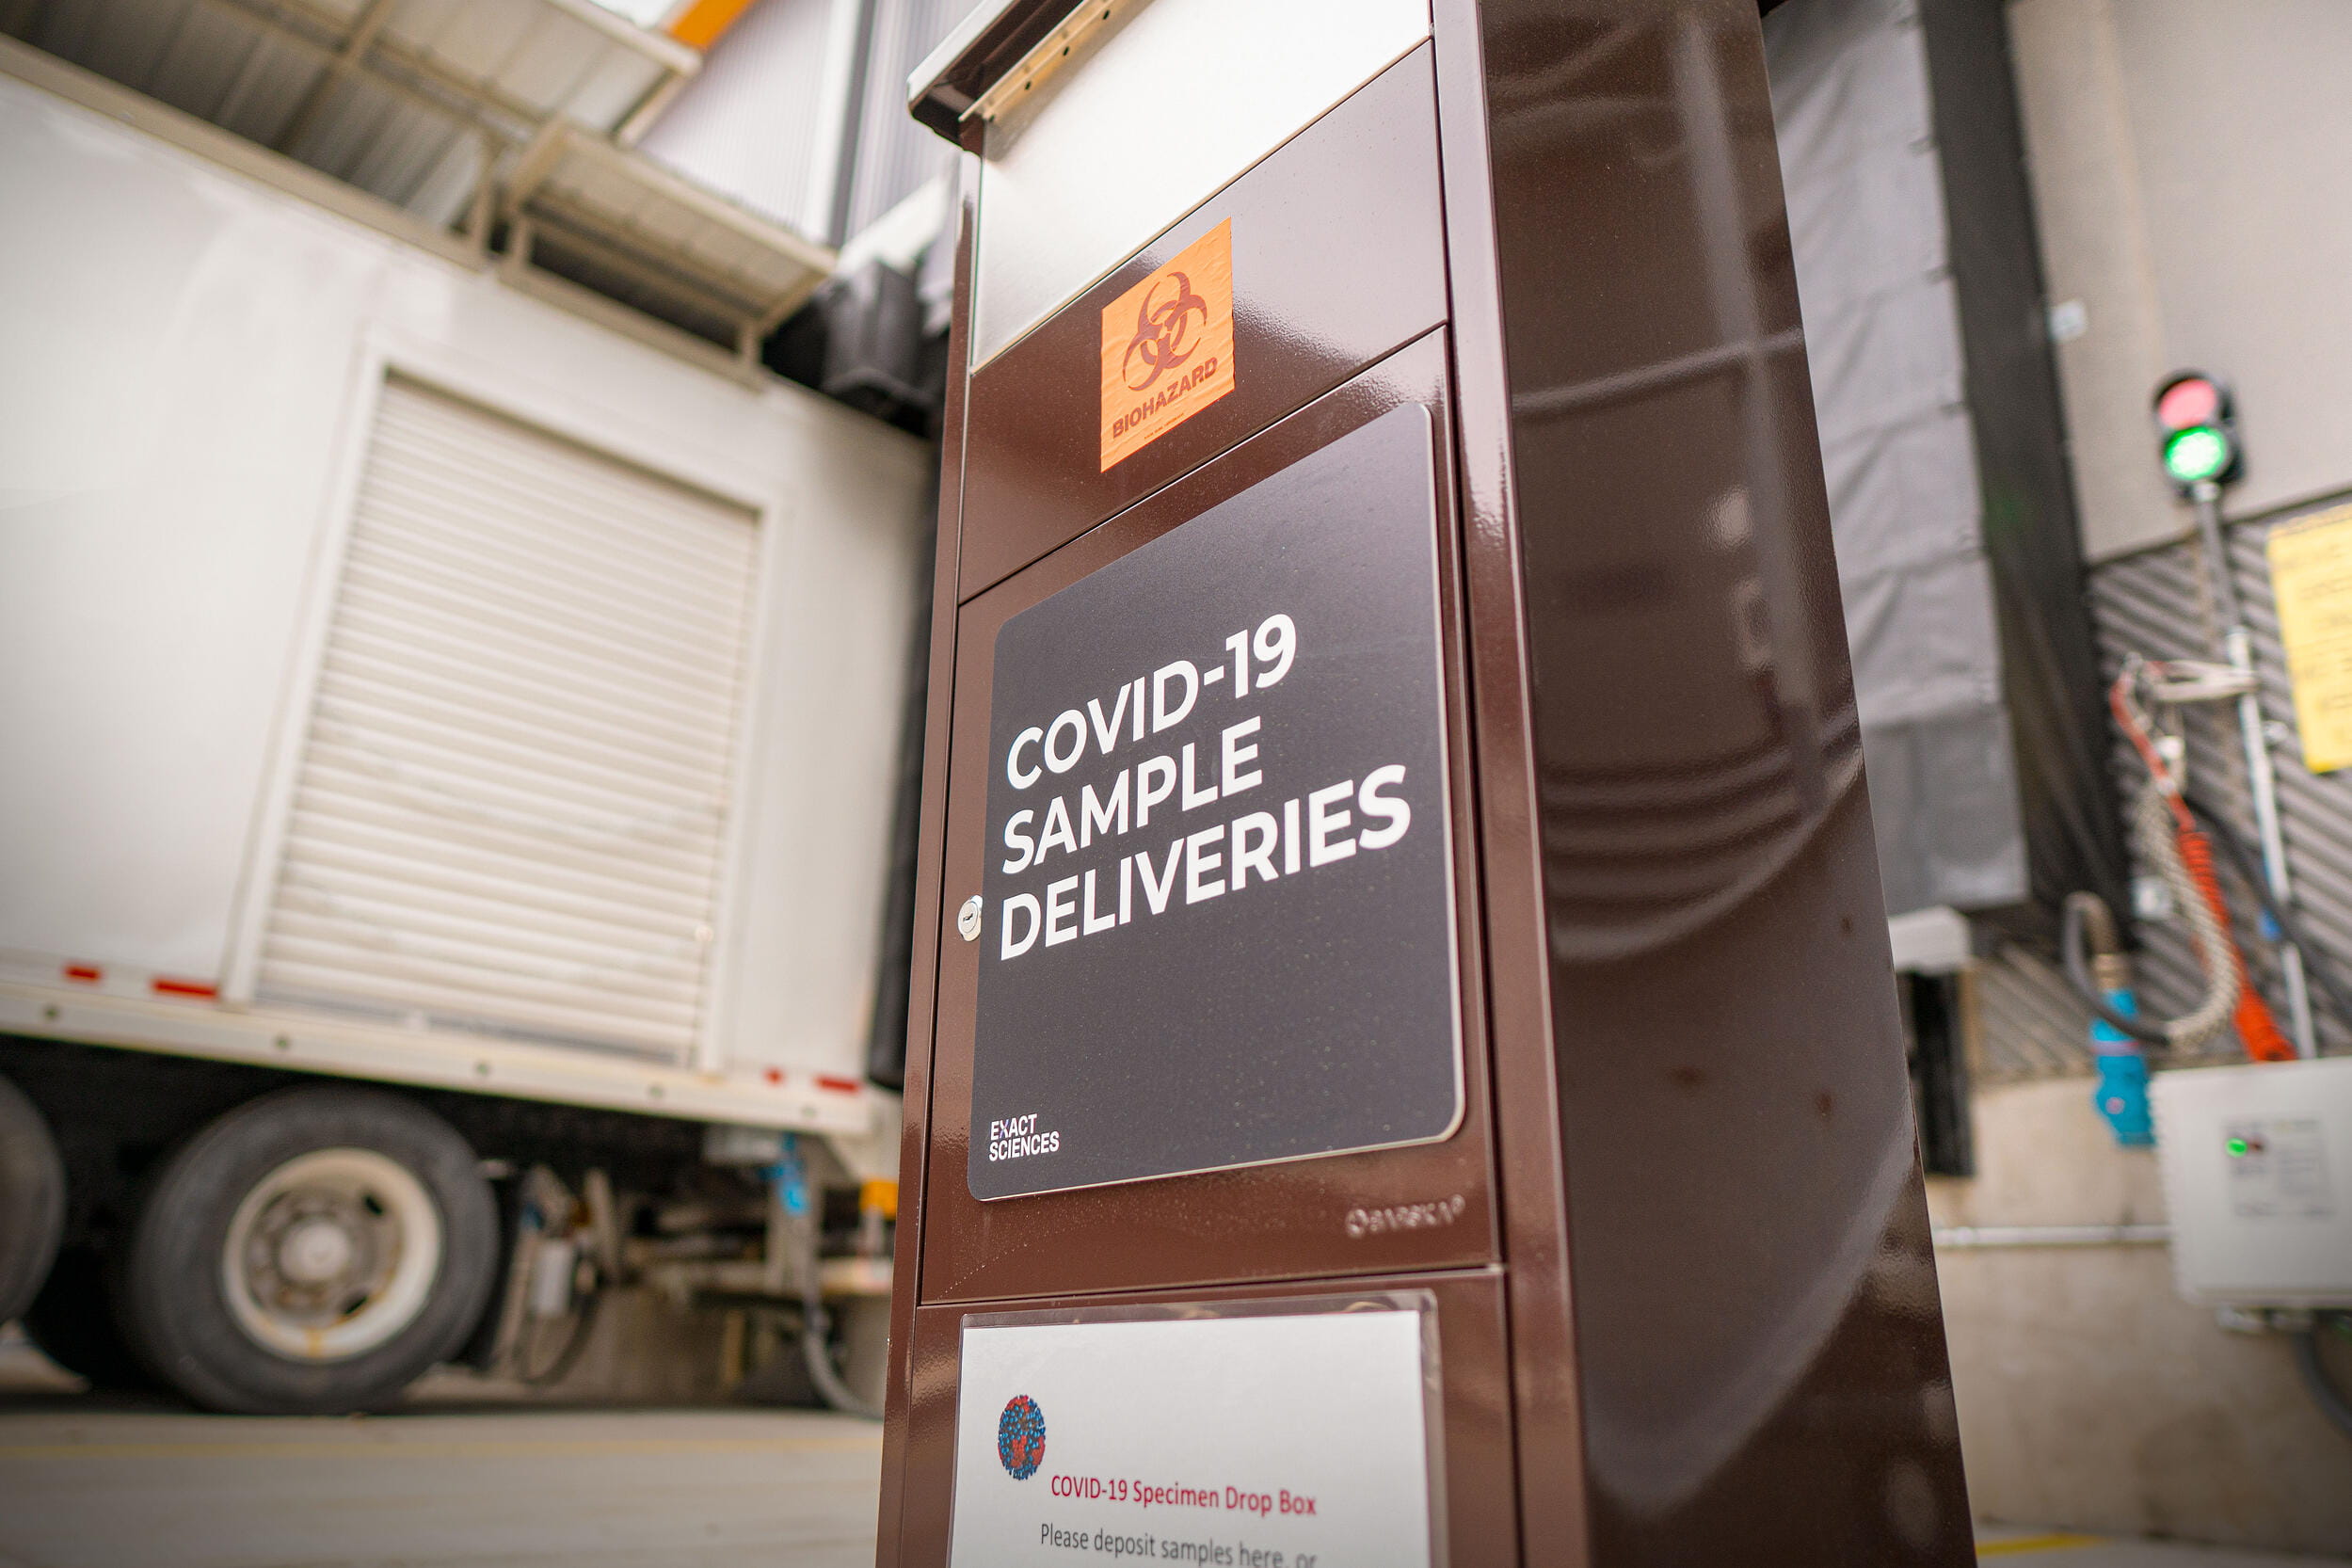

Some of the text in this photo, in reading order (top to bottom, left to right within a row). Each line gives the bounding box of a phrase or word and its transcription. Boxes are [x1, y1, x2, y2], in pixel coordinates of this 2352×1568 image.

[1112, 357, 1219, 440] BIOHAZARD
[1006, 613, 1298, 791] COVID-19
[1001, 715, 1263, 875] SAMPLE
[1000, 764, 1412, 962] DELIVERIES
[988, 1130, 1061, 1162] SCIENCES
[990, 1113, 1038, 1142] EXACT
[1051, 1475, 1317, 1518] COVID-19 Specimen Drop Box
[1041, 1522, 1317, 1568] Please deposit samples here or
